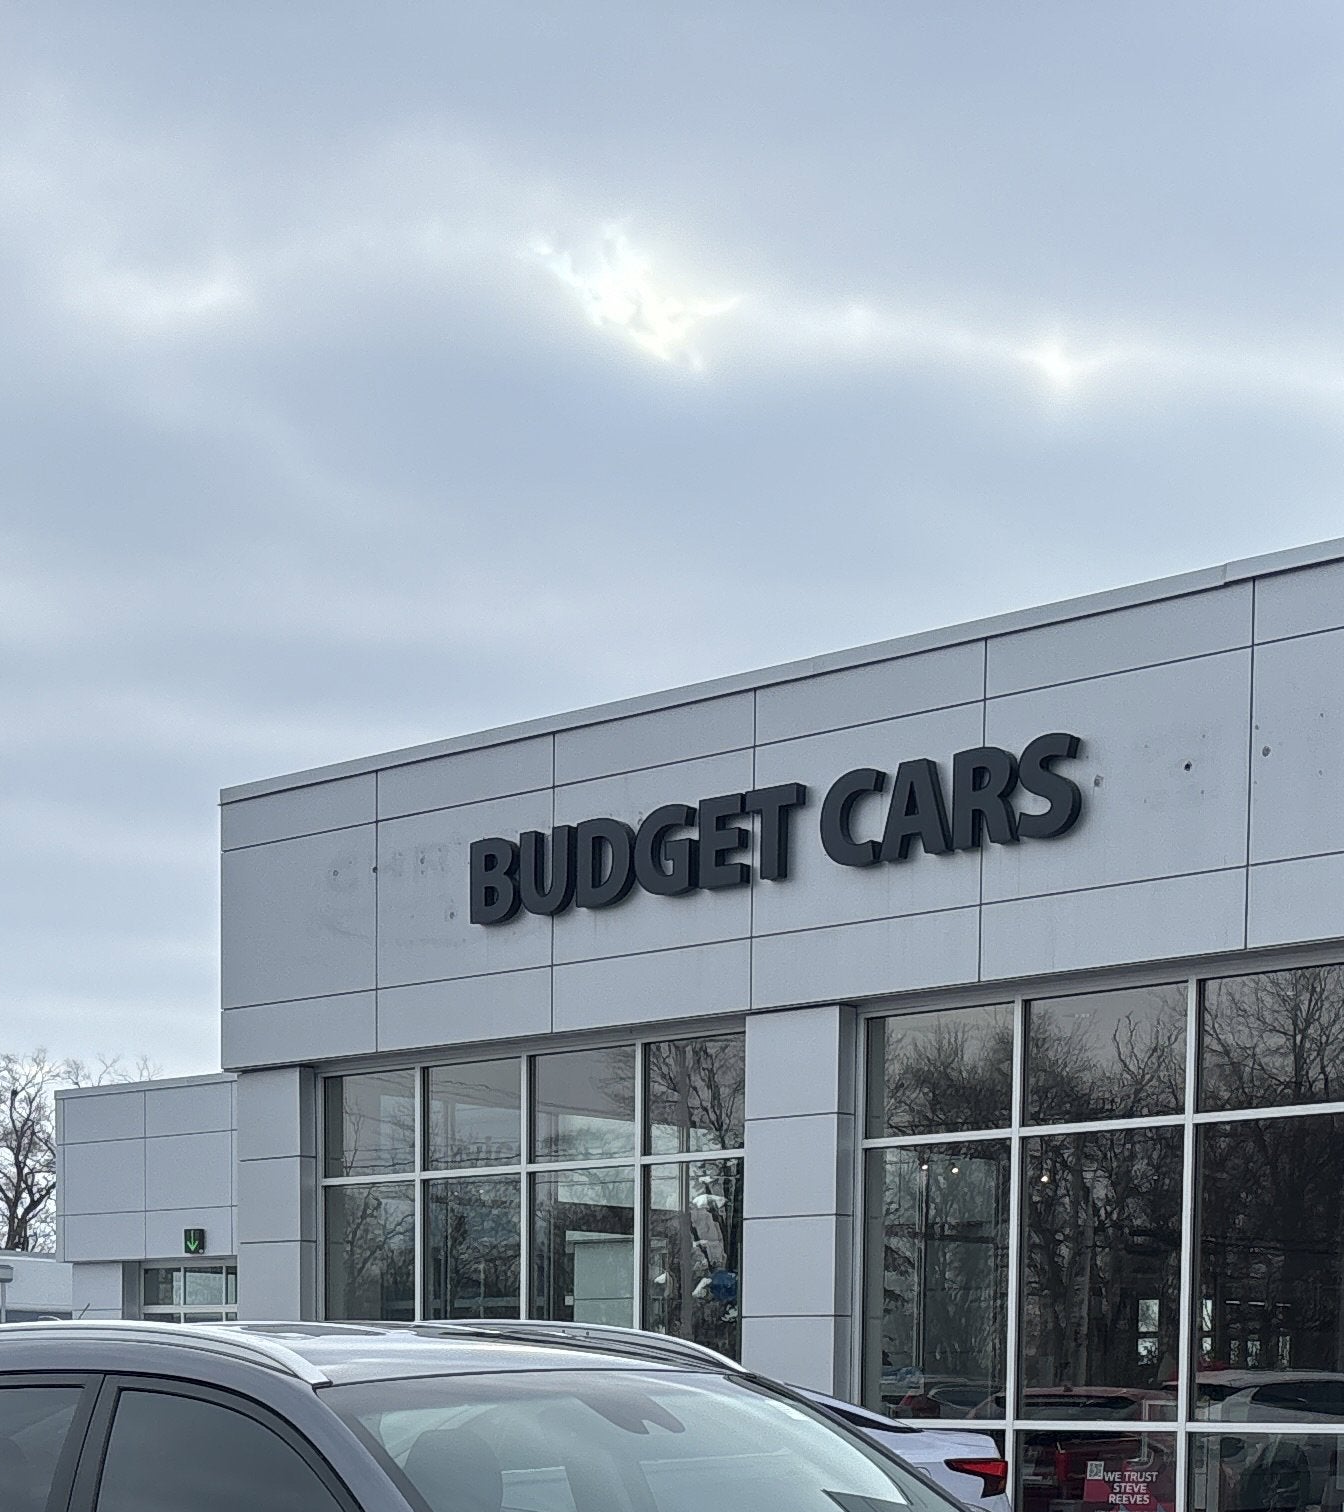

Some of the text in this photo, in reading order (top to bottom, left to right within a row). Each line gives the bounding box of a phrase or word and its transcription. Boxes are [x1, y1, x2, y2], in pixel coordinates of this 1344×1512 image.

[469, 732, 1083, 926] BUDGET CARS
[1103, 1471, 1159, 1482] WE TRUST
[1112, 1483, 1147, 1493] STEVE
[1108, 1494, 1150, 1505] REEVES
